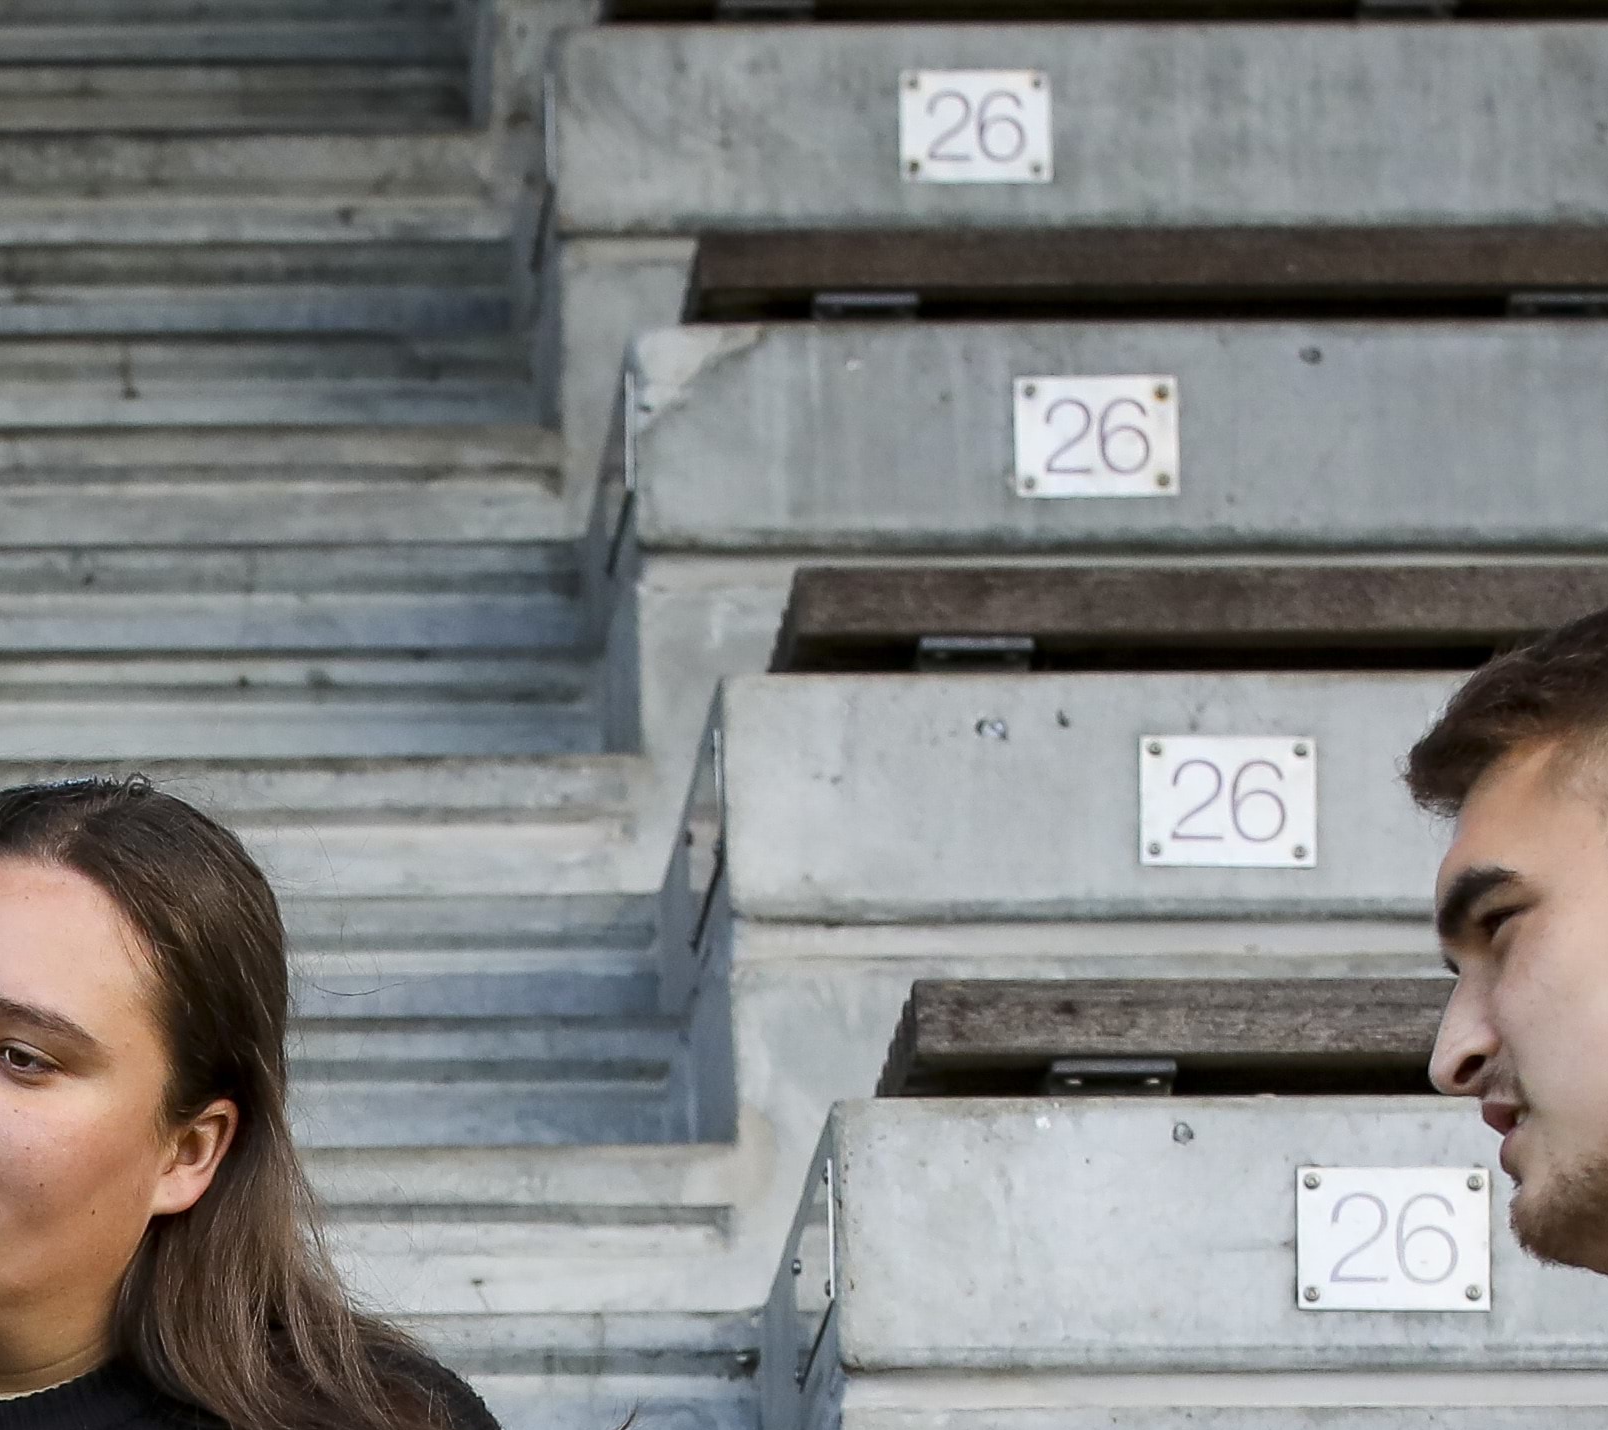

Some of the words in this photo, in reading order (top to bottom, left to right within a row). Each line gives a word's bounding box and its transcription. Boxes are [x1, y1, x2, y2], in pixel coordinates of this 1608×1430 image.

[926, 90, 1028, 164] 26
[1043, 397, 1153, 475] 26
[1170, 759, 1287, 843] 26
[1329, 1191, 1459, 1284] 26
